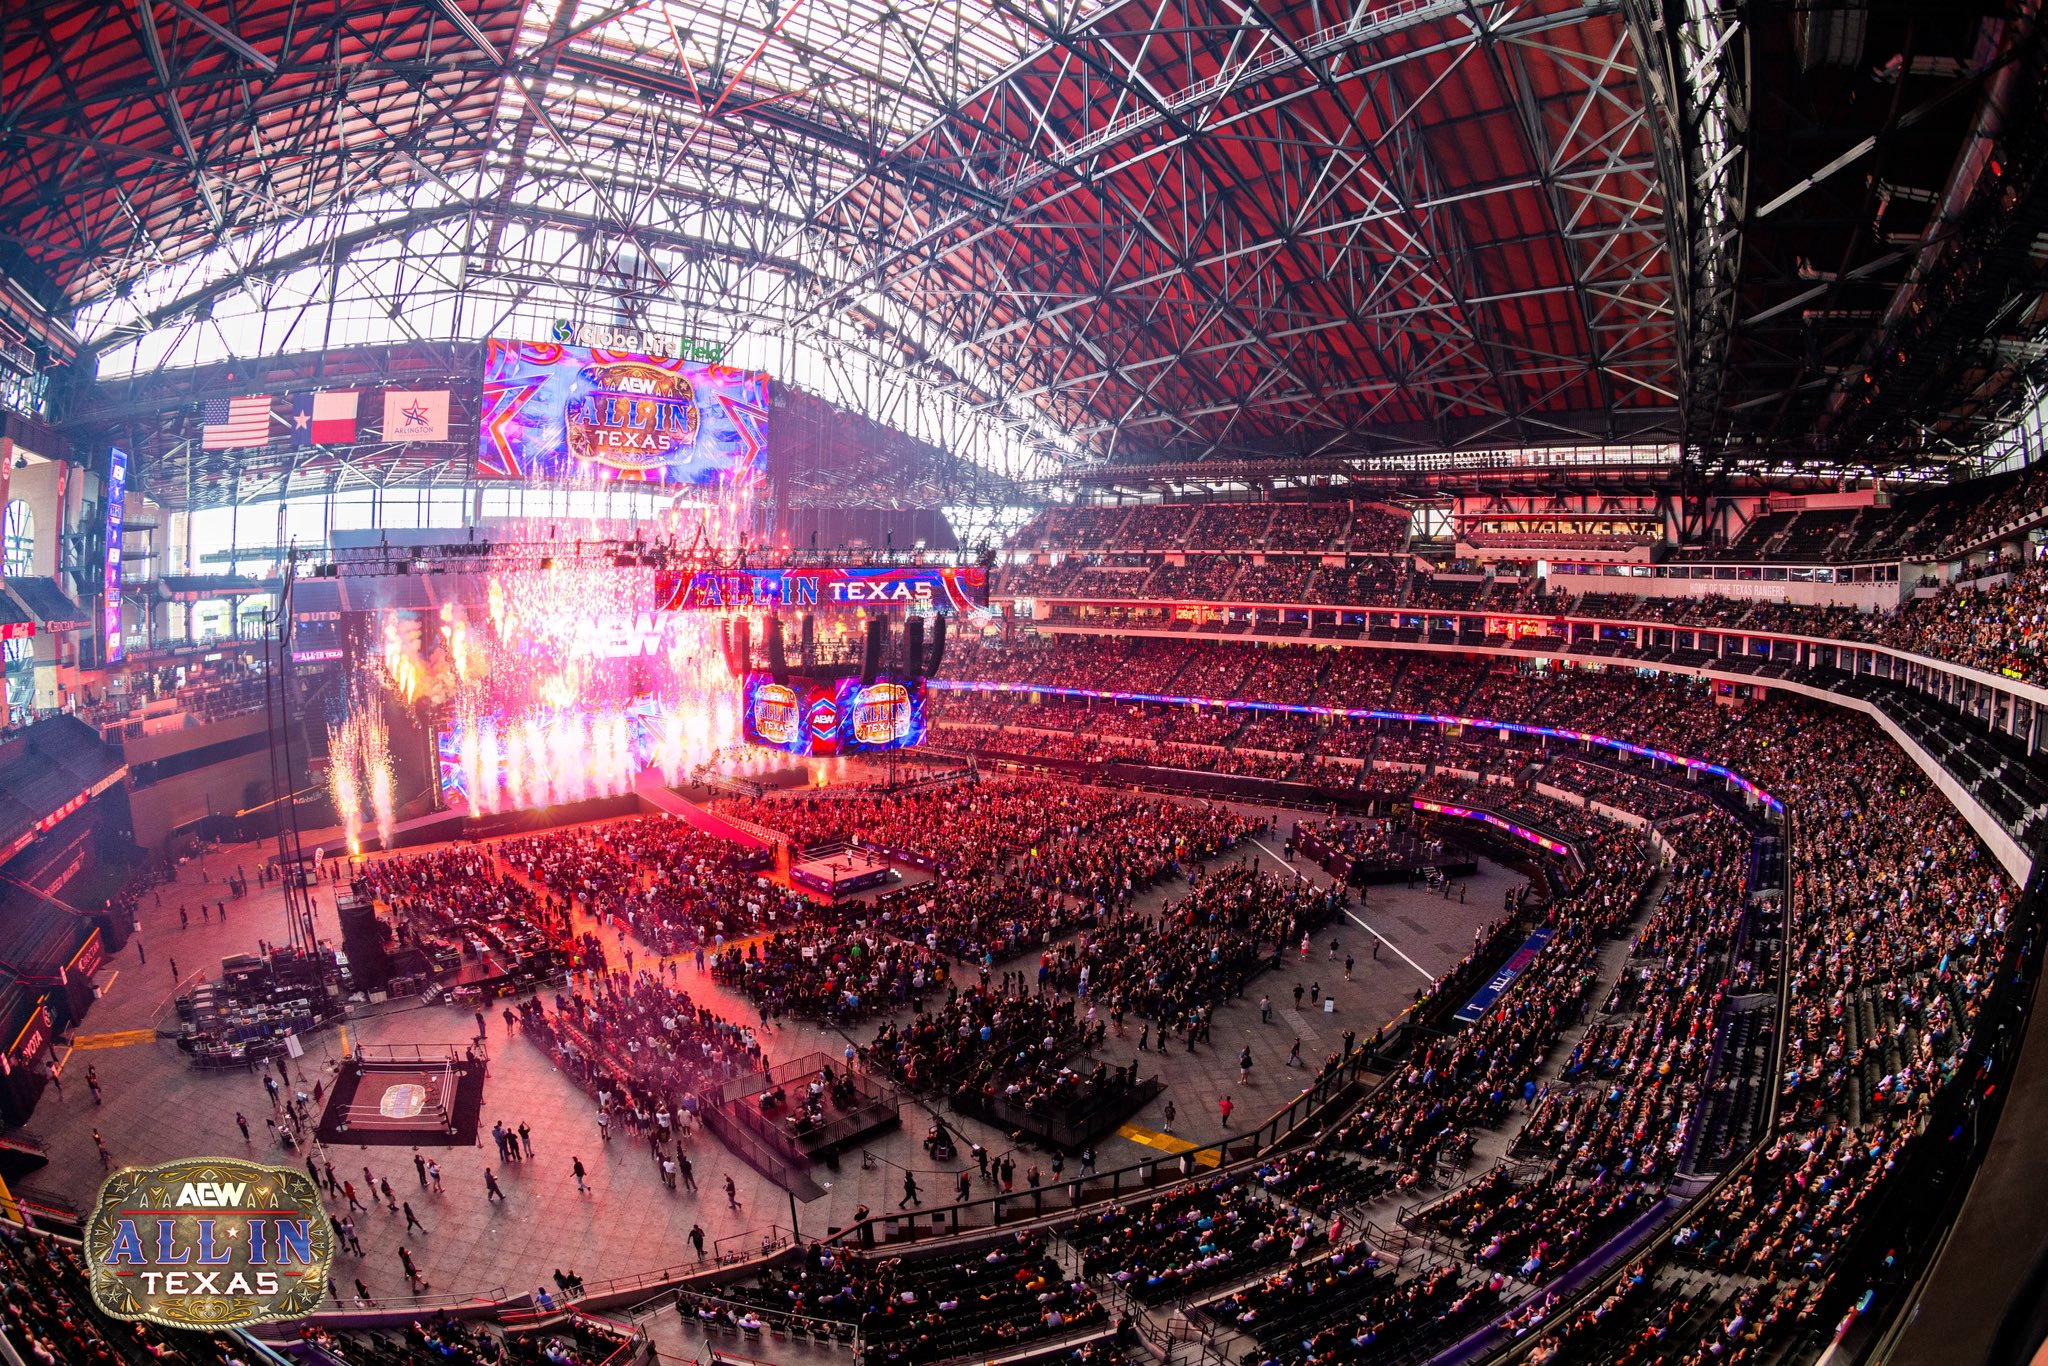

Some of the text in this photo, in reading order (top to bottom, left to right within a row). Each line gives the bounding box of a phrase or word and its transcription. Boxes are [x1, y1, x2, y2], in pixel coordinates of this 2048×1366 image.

[580, 325, 722, 361] Globe Life Field
[617, 376, 657, 395] AEW
[575, 396, 690, 433] ALL IN
[394, 426, 434, 434] ARLINGTON
[594, 430, 671, 450] TEXAS
[700, 576, 933, 606] ALL IN TEXAS
[1690, 583, 1785, 597] HOME OF THE TEXAS RANGERS
[763, 720, 790, 733] TEXAS
[813, 714, 835, 724] AEW
[866, 721, 899, 733] TEXAS
[1488, 977, 1511, 992] ALL
